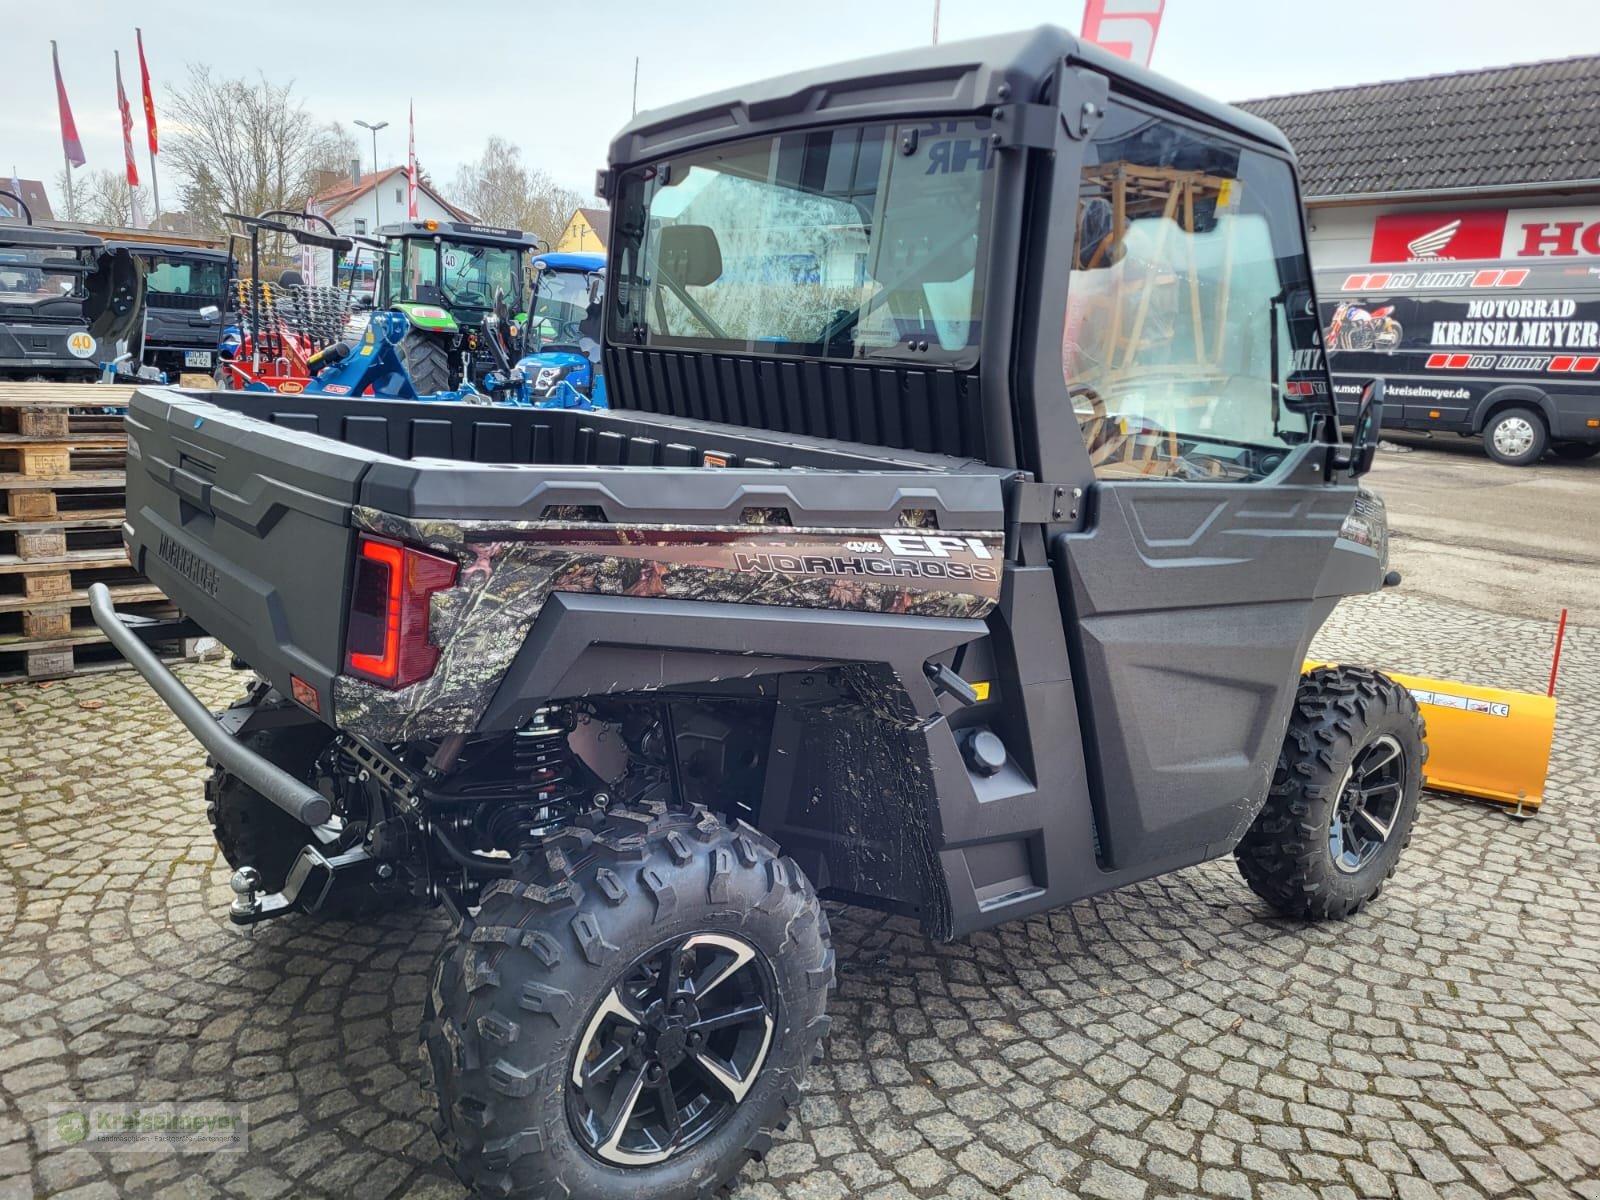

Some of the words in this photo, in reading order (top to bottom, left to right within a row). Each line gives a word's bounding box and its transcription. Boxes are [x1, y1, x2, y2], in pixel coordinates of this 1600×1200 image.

[446, 255, 455, 266] 40
[1415, 272, 1476, 288] LIMIT
[1467, 299, 1575, 318] MOTORRAD
[1430, 321, 1599, 347] KREISELMEYER
[72, 335, 92, 350] 40
[1495, 356, 1550, 371] LIMIT
[880, 534, 993, 559] EFI
